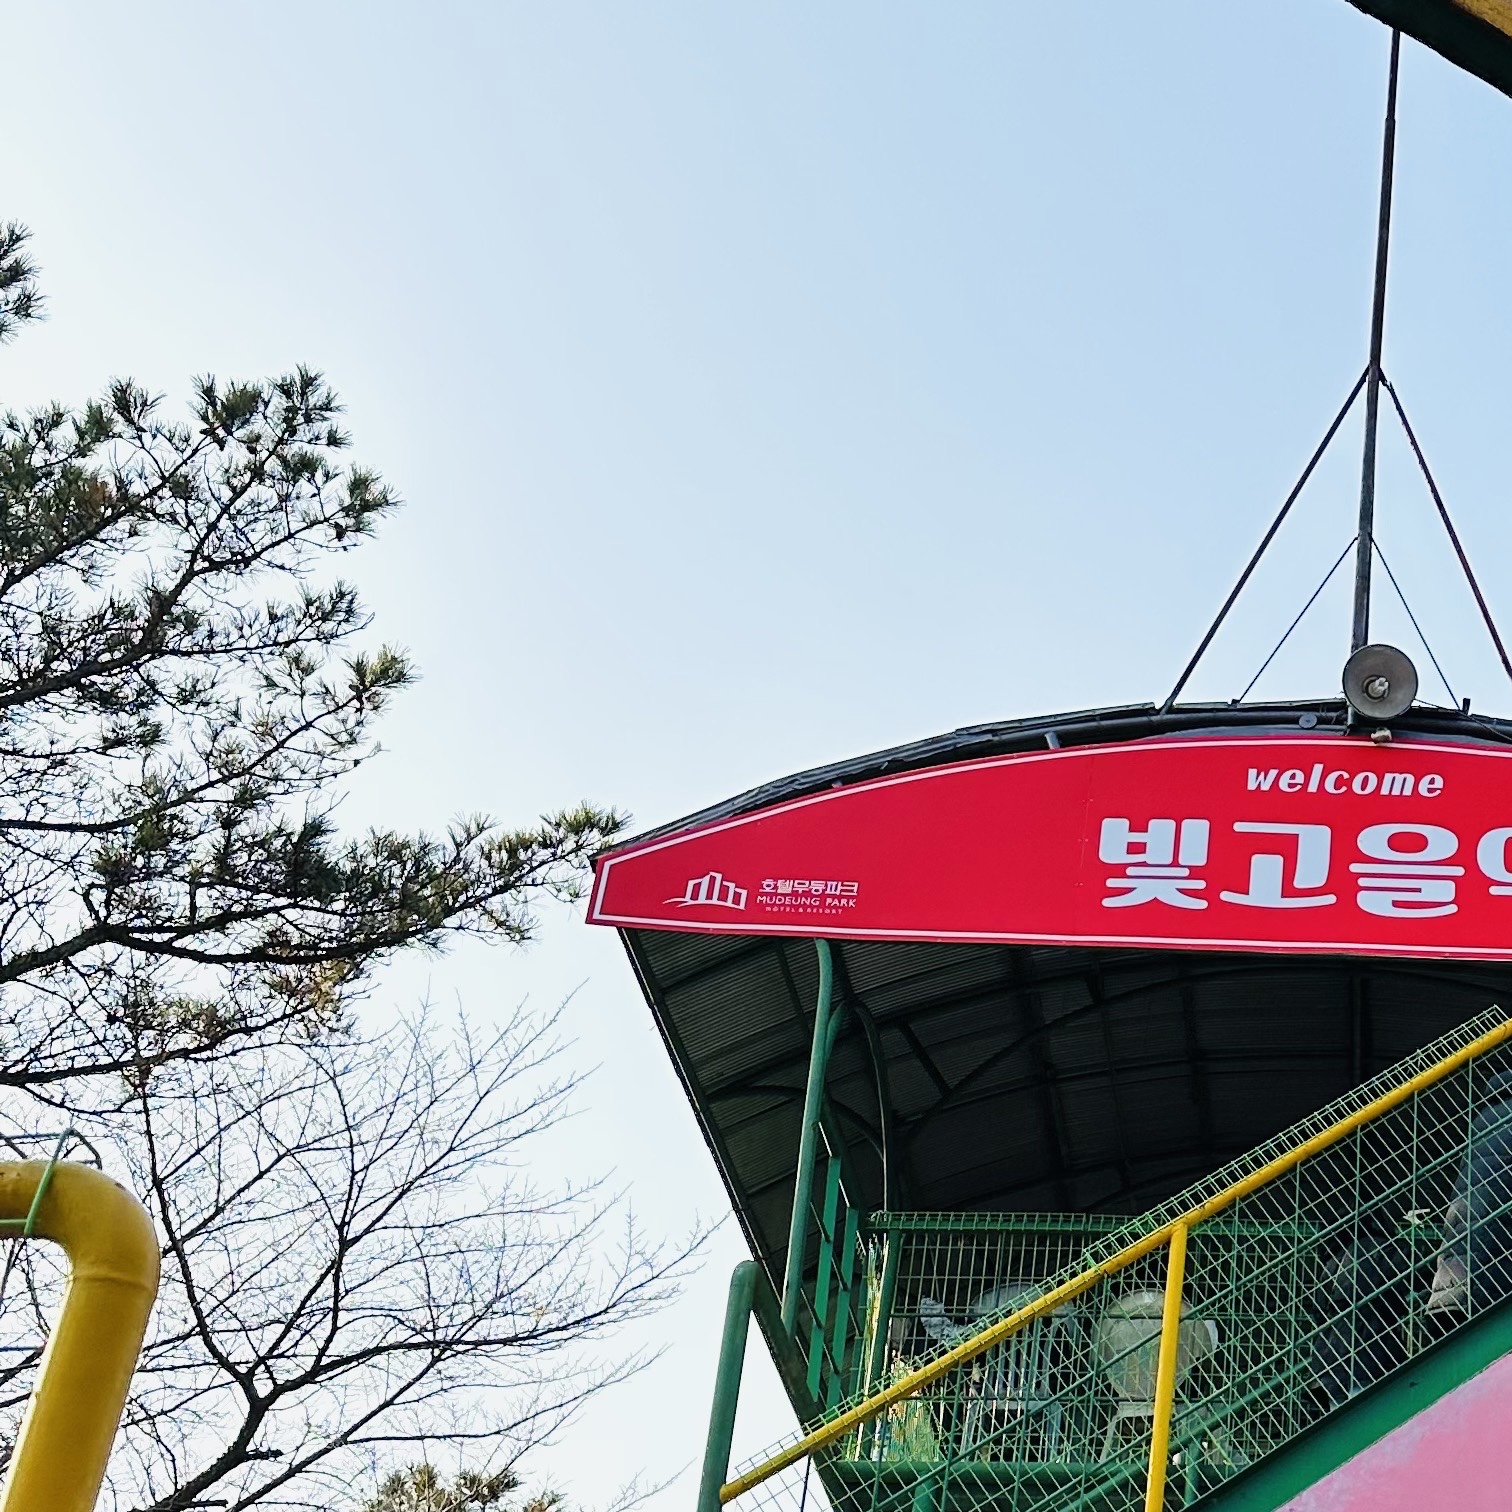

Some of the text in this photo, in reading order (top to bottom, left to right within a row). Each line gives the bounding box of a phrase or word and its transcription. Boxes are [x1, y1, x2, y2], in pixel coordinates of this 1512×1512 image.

[1246, 763, 1446, 798] welcome
[759, 878, 859, 896] 호텔무등파크
[756, 895, 857, 908] MUDEUNG PARK
